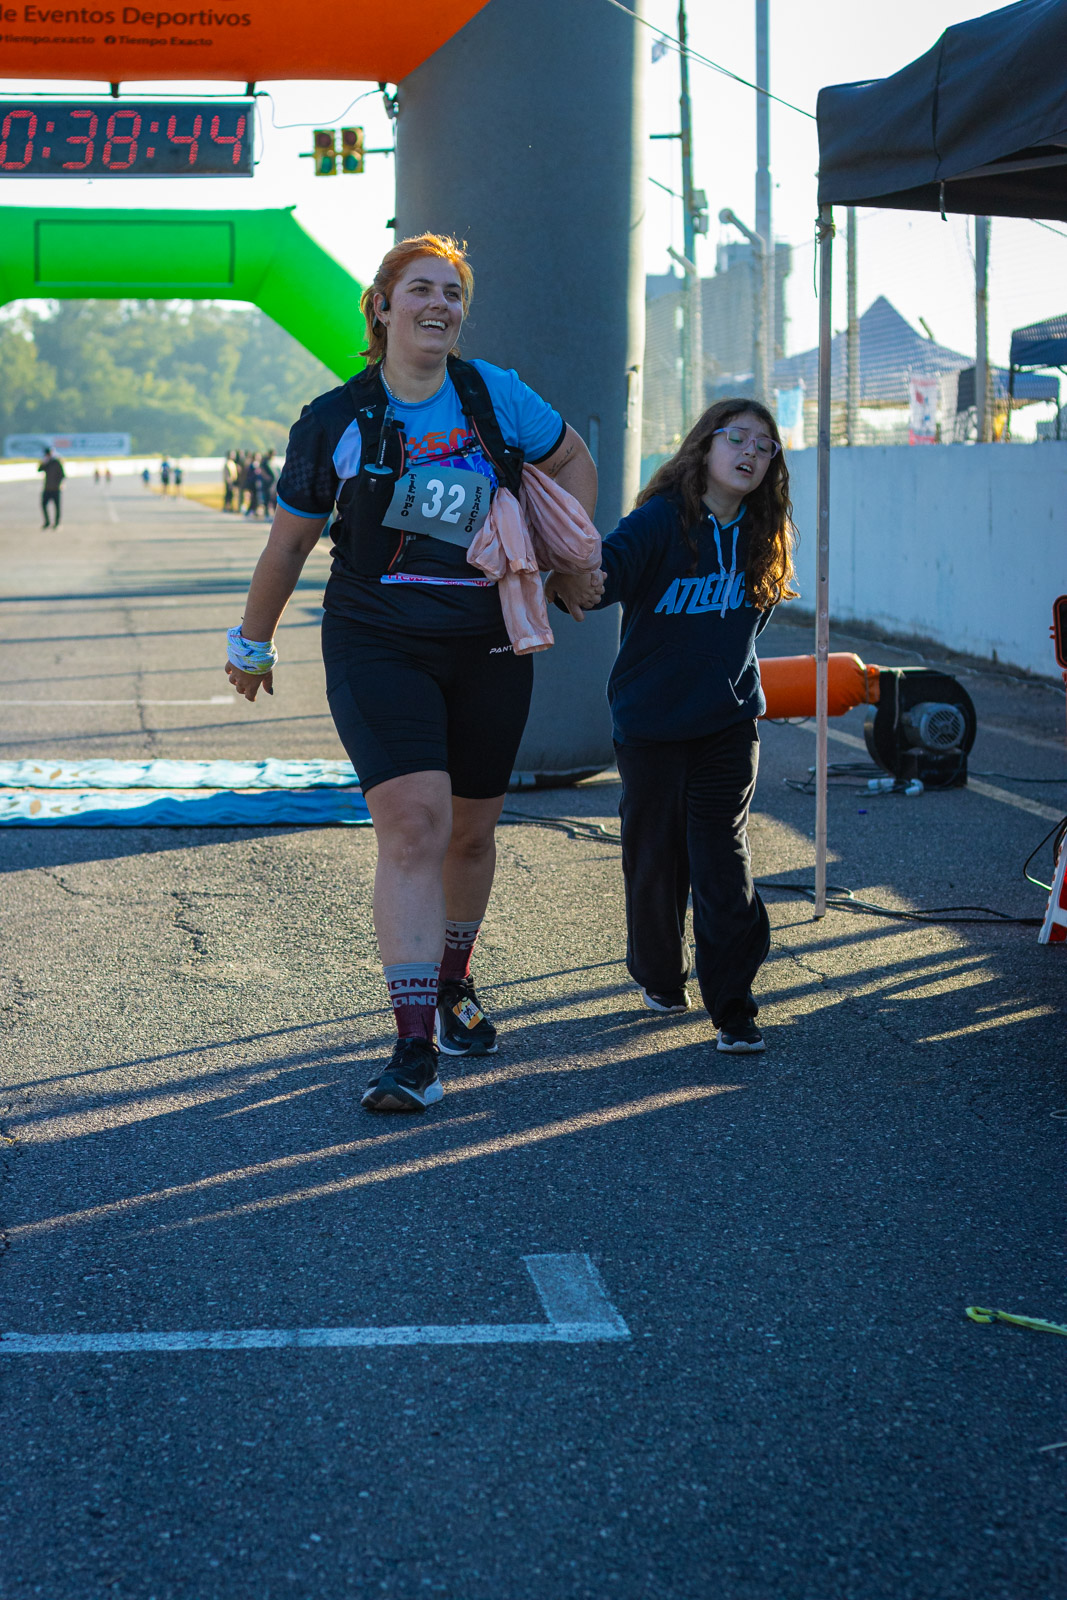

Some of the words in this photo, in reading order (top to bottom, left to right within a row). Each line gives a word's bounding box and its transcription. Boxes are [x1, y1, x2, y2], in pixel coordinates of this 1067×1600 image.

[0, 3, 17, 22] e
[24, 5, 116, 24] Eventos
[122, 7, 252, 29] Deportivos
[119, 36, 167, 47] Tiempo
[170, 37, 213, 46] Exacto
[400, 473, 417, 517] TIEMPO
[421, 478, 466, 524] 32
[464, 486, 482, 533] EXACTO
[654, 571, 753, 615] ATLETIC
[489, 644, 514, 655] PANT
